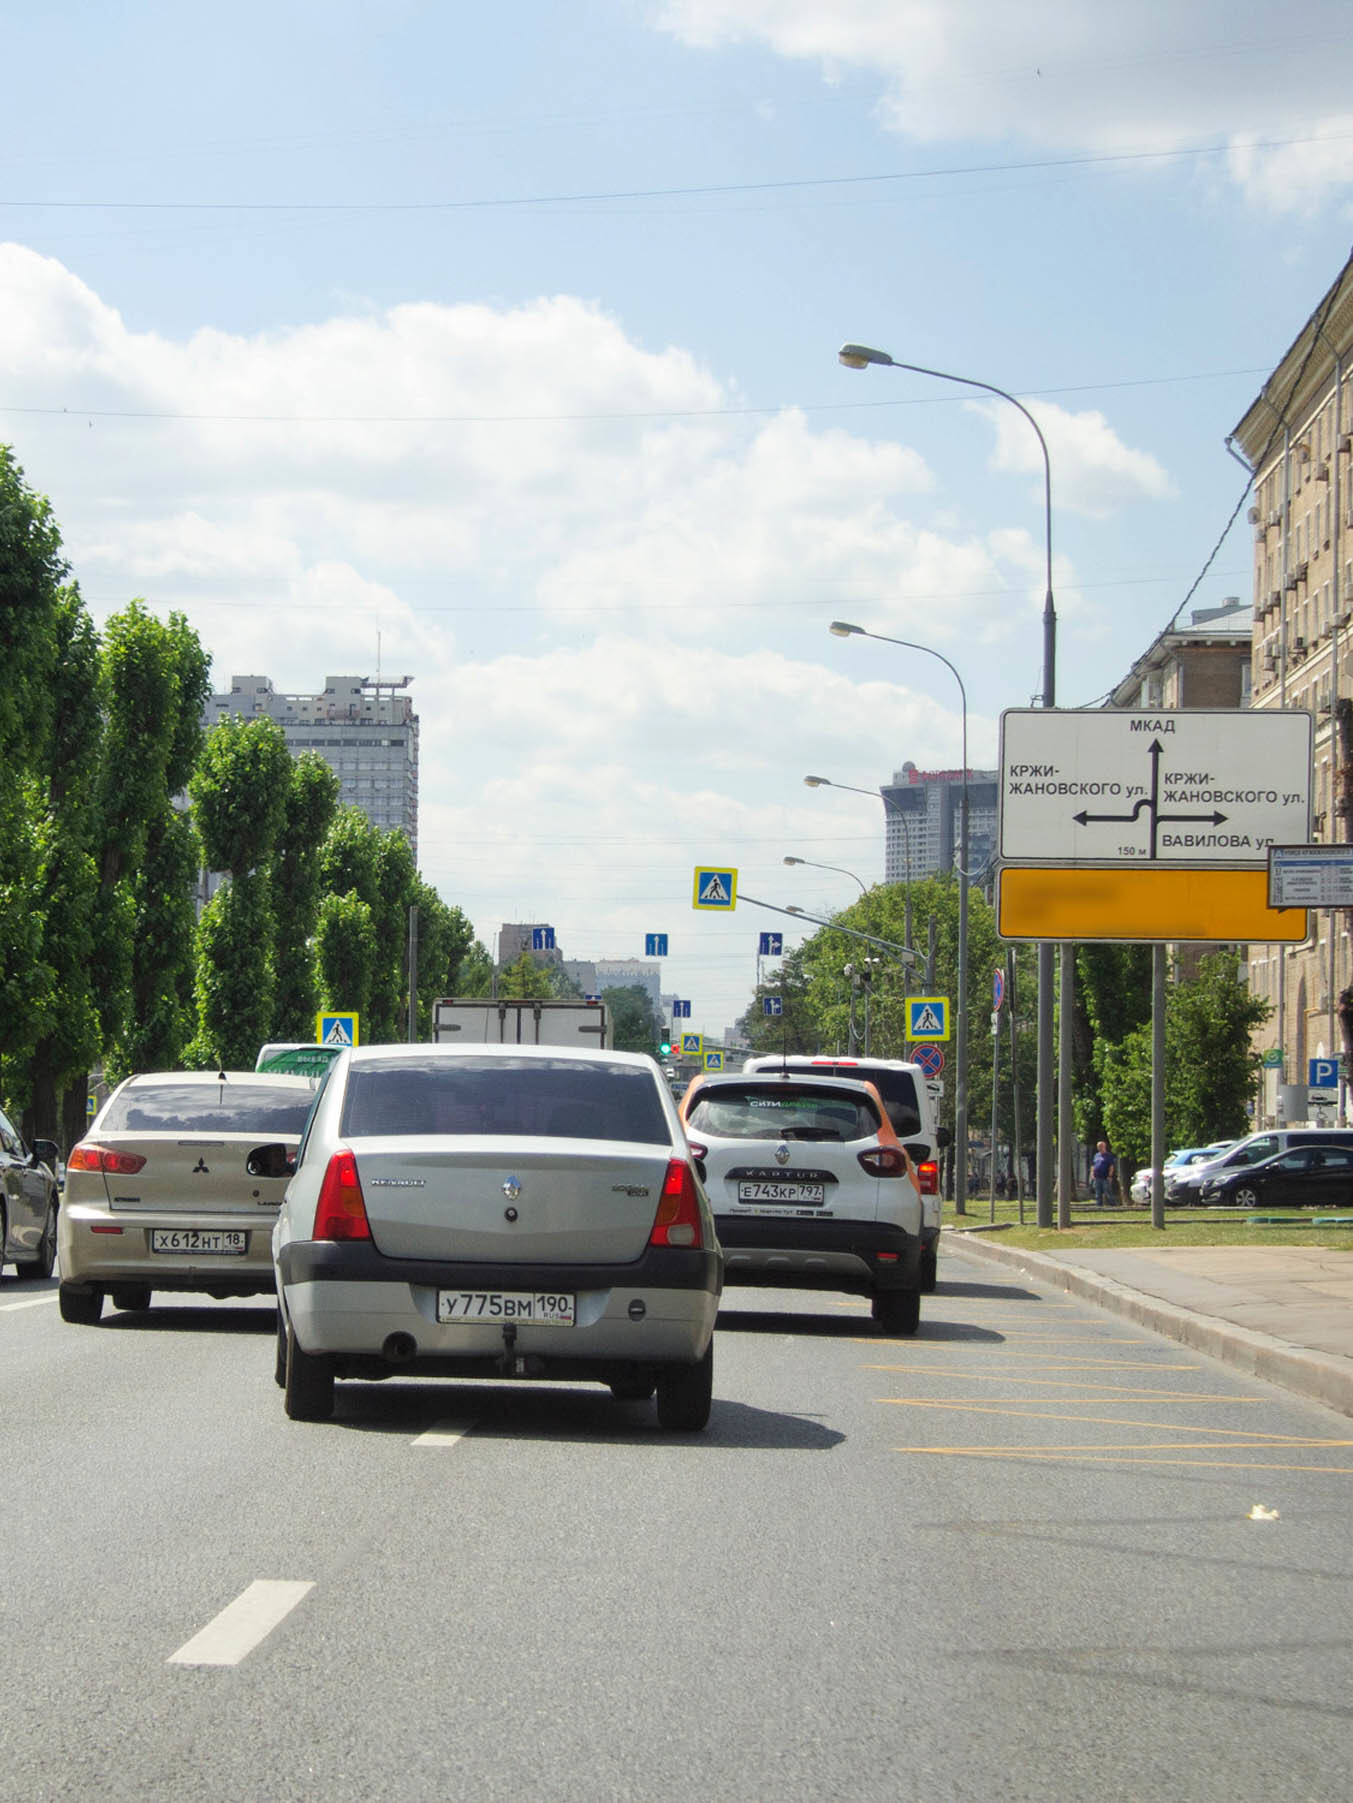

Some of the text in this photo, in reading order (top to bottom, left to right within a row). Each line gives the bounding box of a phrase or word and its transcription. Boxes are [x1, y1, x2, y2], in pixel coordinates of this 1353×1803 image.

[1130, 719, 1176, 734] МКАД
[1009, 765, 1060, 777] КРЖИ-
[1164, 773, 1216, 785] КРЖИ-
[1009, 783, 1148, 799] ЖАНОВСКОГО ул.
[1163, 791, 1305, 806] ЖАНОВСКОГО ул.
[1162, 835, 1275, 850] ВАВИЛОВА ул
[1117, 847, 1147, 856] 150 м
[225, 1233, 241, 1246] 18
[536, 1295, 568, 1313] 190
